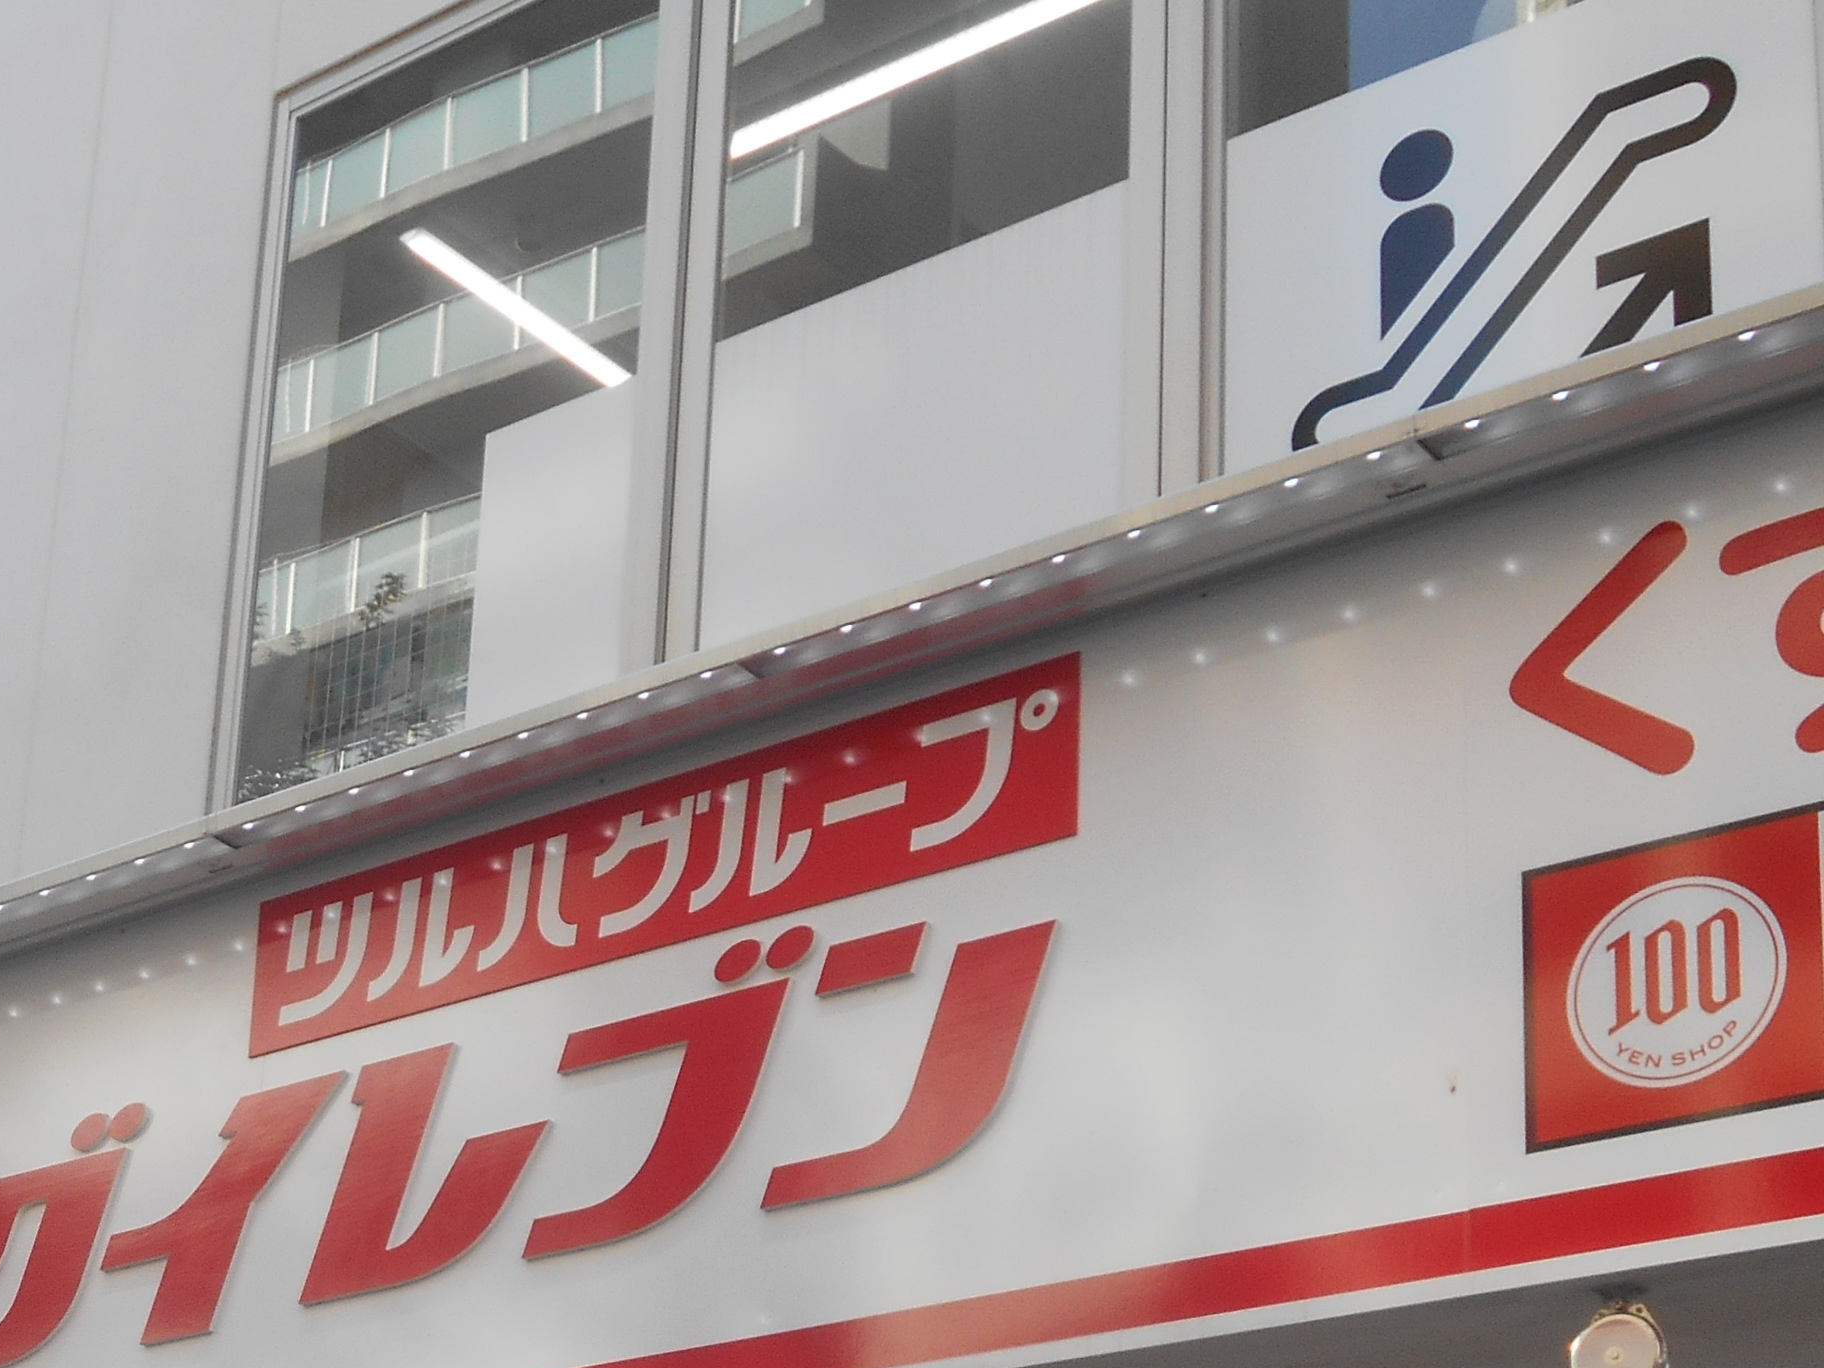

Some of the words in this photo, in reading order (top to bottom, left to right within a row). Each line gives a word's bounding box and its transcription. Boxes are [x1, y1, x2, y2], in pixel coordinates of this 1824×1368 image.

[277, 688, 1059, 1027] ツルハグループ
[1605, 907, 1744, 1036] 100
[1614, 1039, 1664, 1069] YEN
[1670, 1018, 1740, 1068] SHOP
